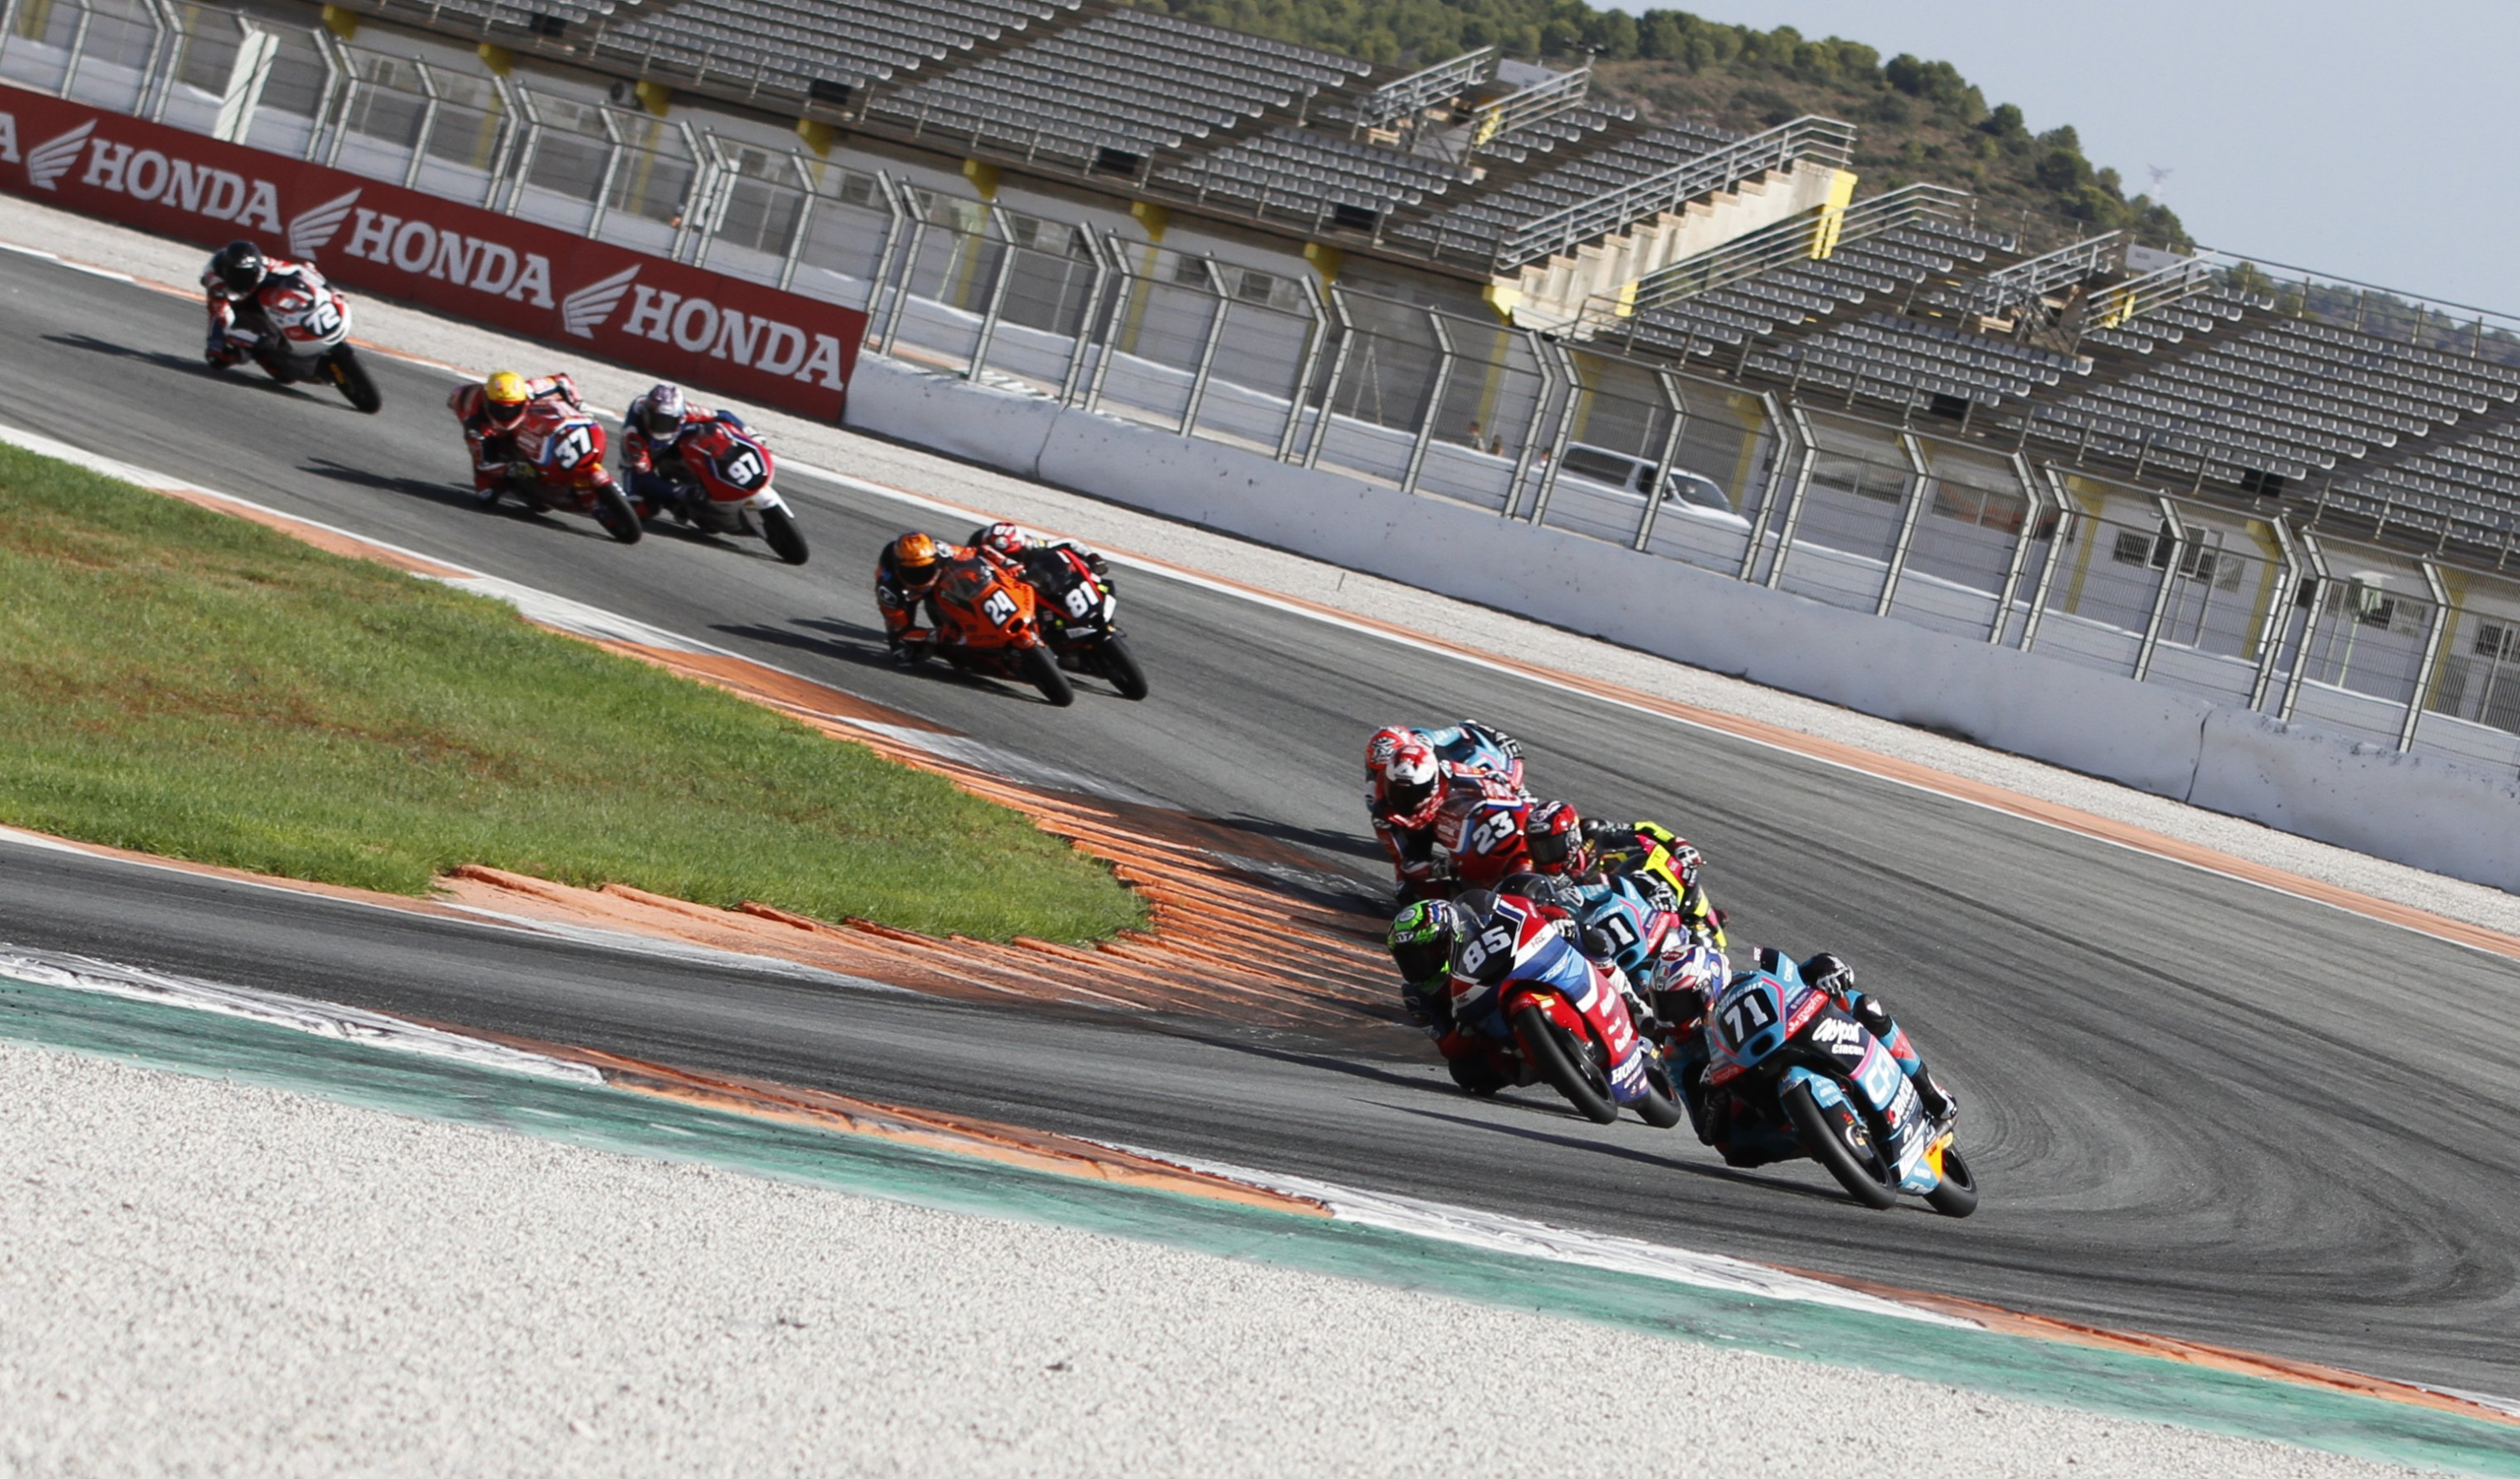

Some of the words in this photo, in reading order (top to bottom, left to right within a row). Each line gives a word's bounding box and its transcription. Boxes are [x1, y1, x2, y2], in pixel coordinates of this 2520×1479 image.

[82, 137, 283, 234] HONDA
[344, 207, 555, 310] HONDA
[304, 302, 342, 335] 72
[622, 282, 844, 391] HONDA
[554, 426, 592, 469] 37
[728, 452, 761, 485] 97
[984, 590, 1017, 626] 24
[1065, 580, 1099, 618] 81
[1472, 810, 1515, 855] 23
[1462, 926, 1512, 974] 85
[1724, 994, 1769, 1043] 71
[1798, 994, 1824, 1021] mapfre
